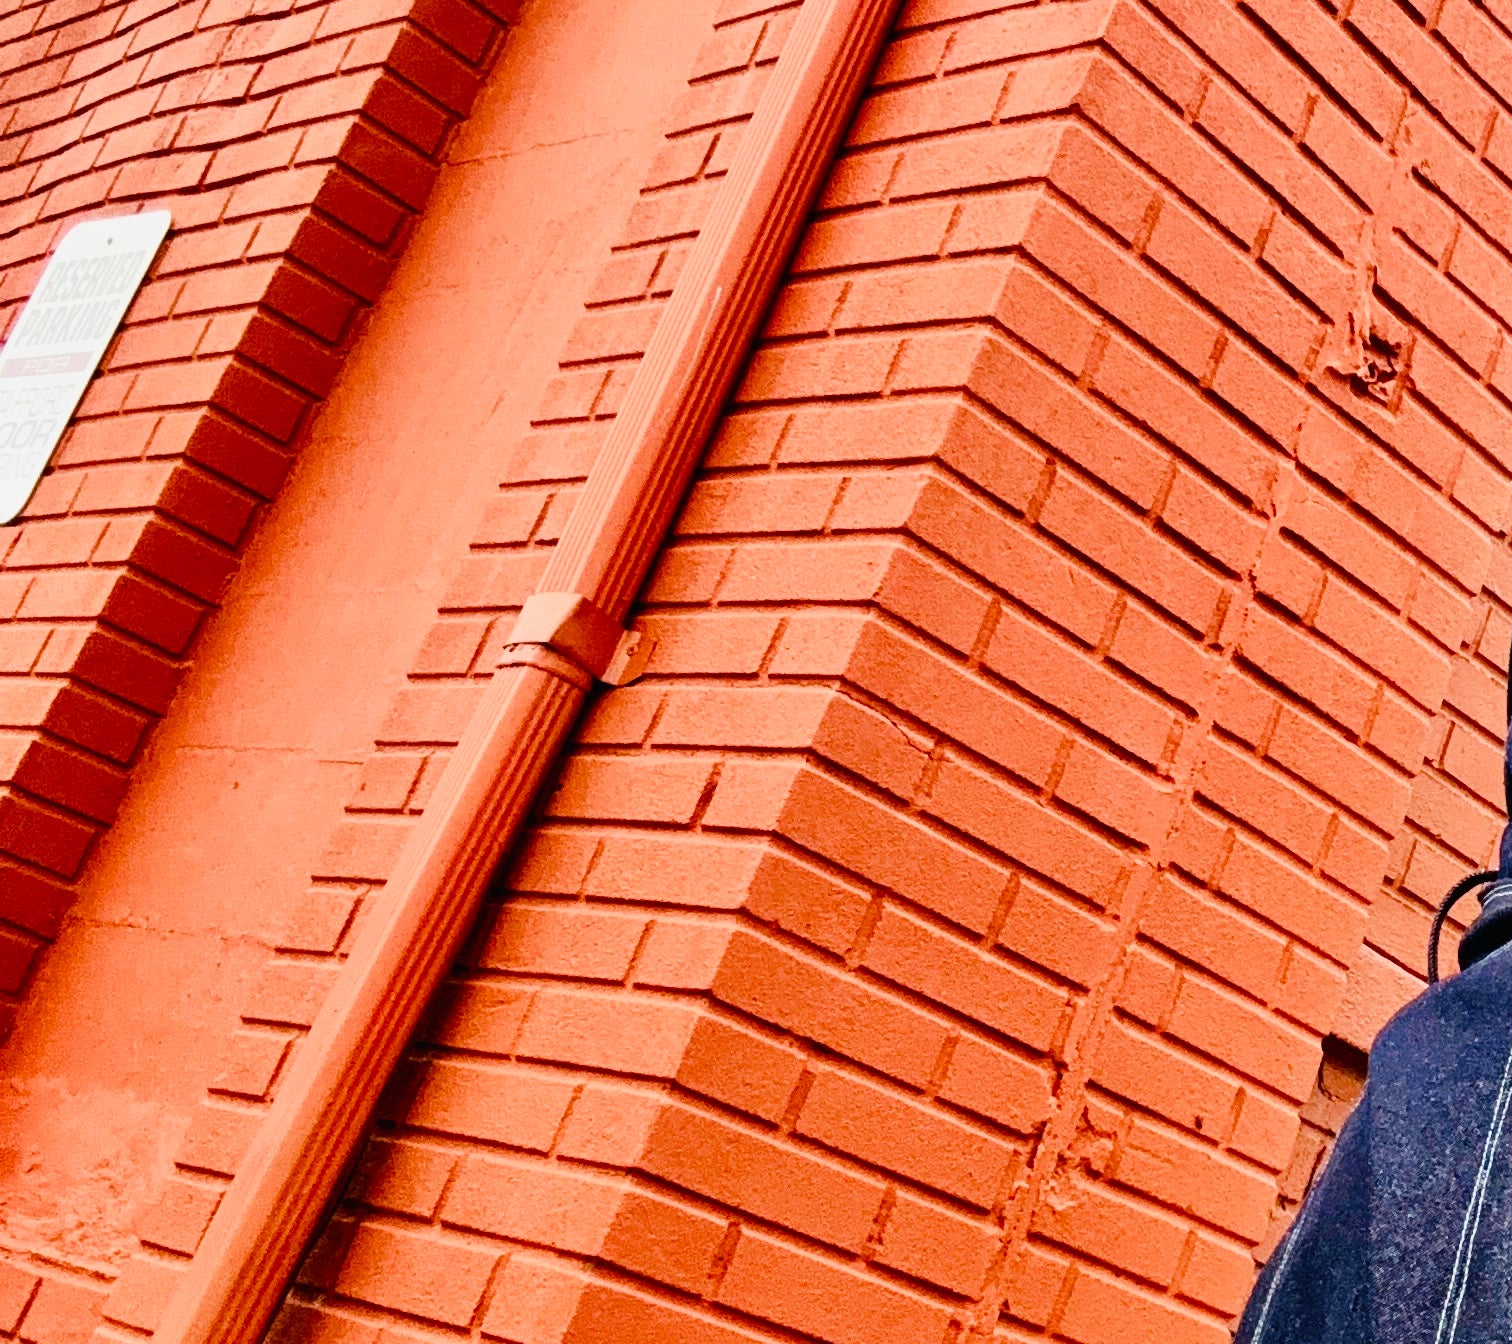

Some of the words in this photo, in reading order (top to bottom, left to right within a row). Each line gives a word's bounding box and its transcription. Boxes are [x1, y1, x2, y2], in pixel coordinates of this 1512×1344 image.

[37, 250, 147, 304] RESERVED
[14, 298, 121, 348] PARKING
[22, 355, 72, 374] FOR
